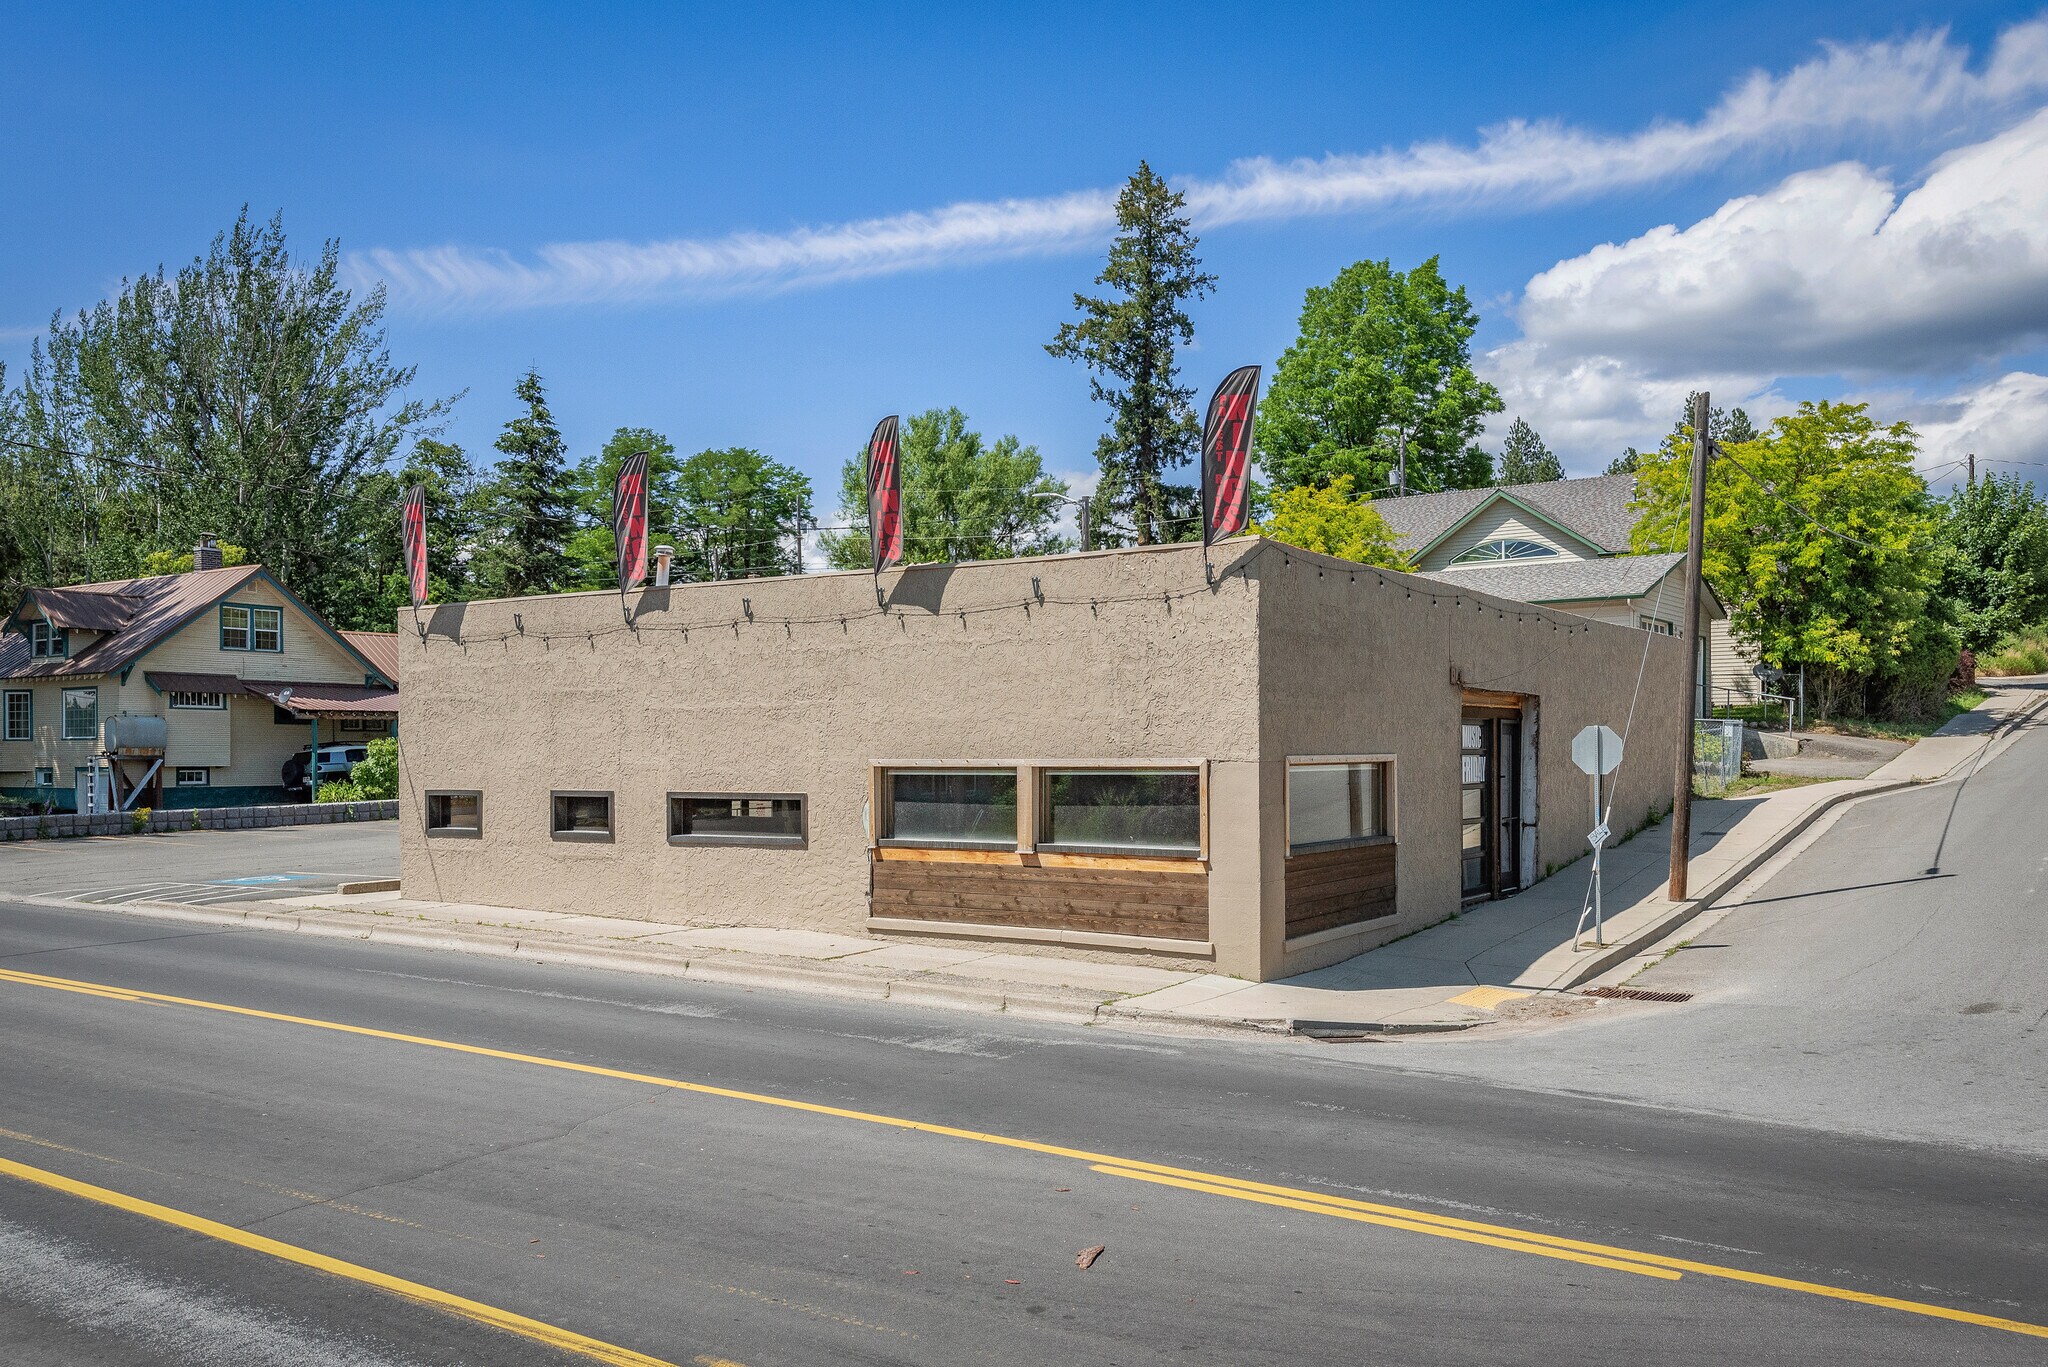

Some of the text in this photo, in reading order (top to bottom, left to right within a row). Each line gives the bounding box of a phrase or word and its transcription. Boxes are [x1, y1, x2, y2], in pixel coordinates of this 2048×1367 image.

[1215, 394, 1227, 462] PRIEST
[1223, 394, 1250, 533] KINGS
[880, 440, 900, 560] KINGS
[1462, 756, 1486, 782] FRIDAY
[1589, 824, 1606, 841] SALE
